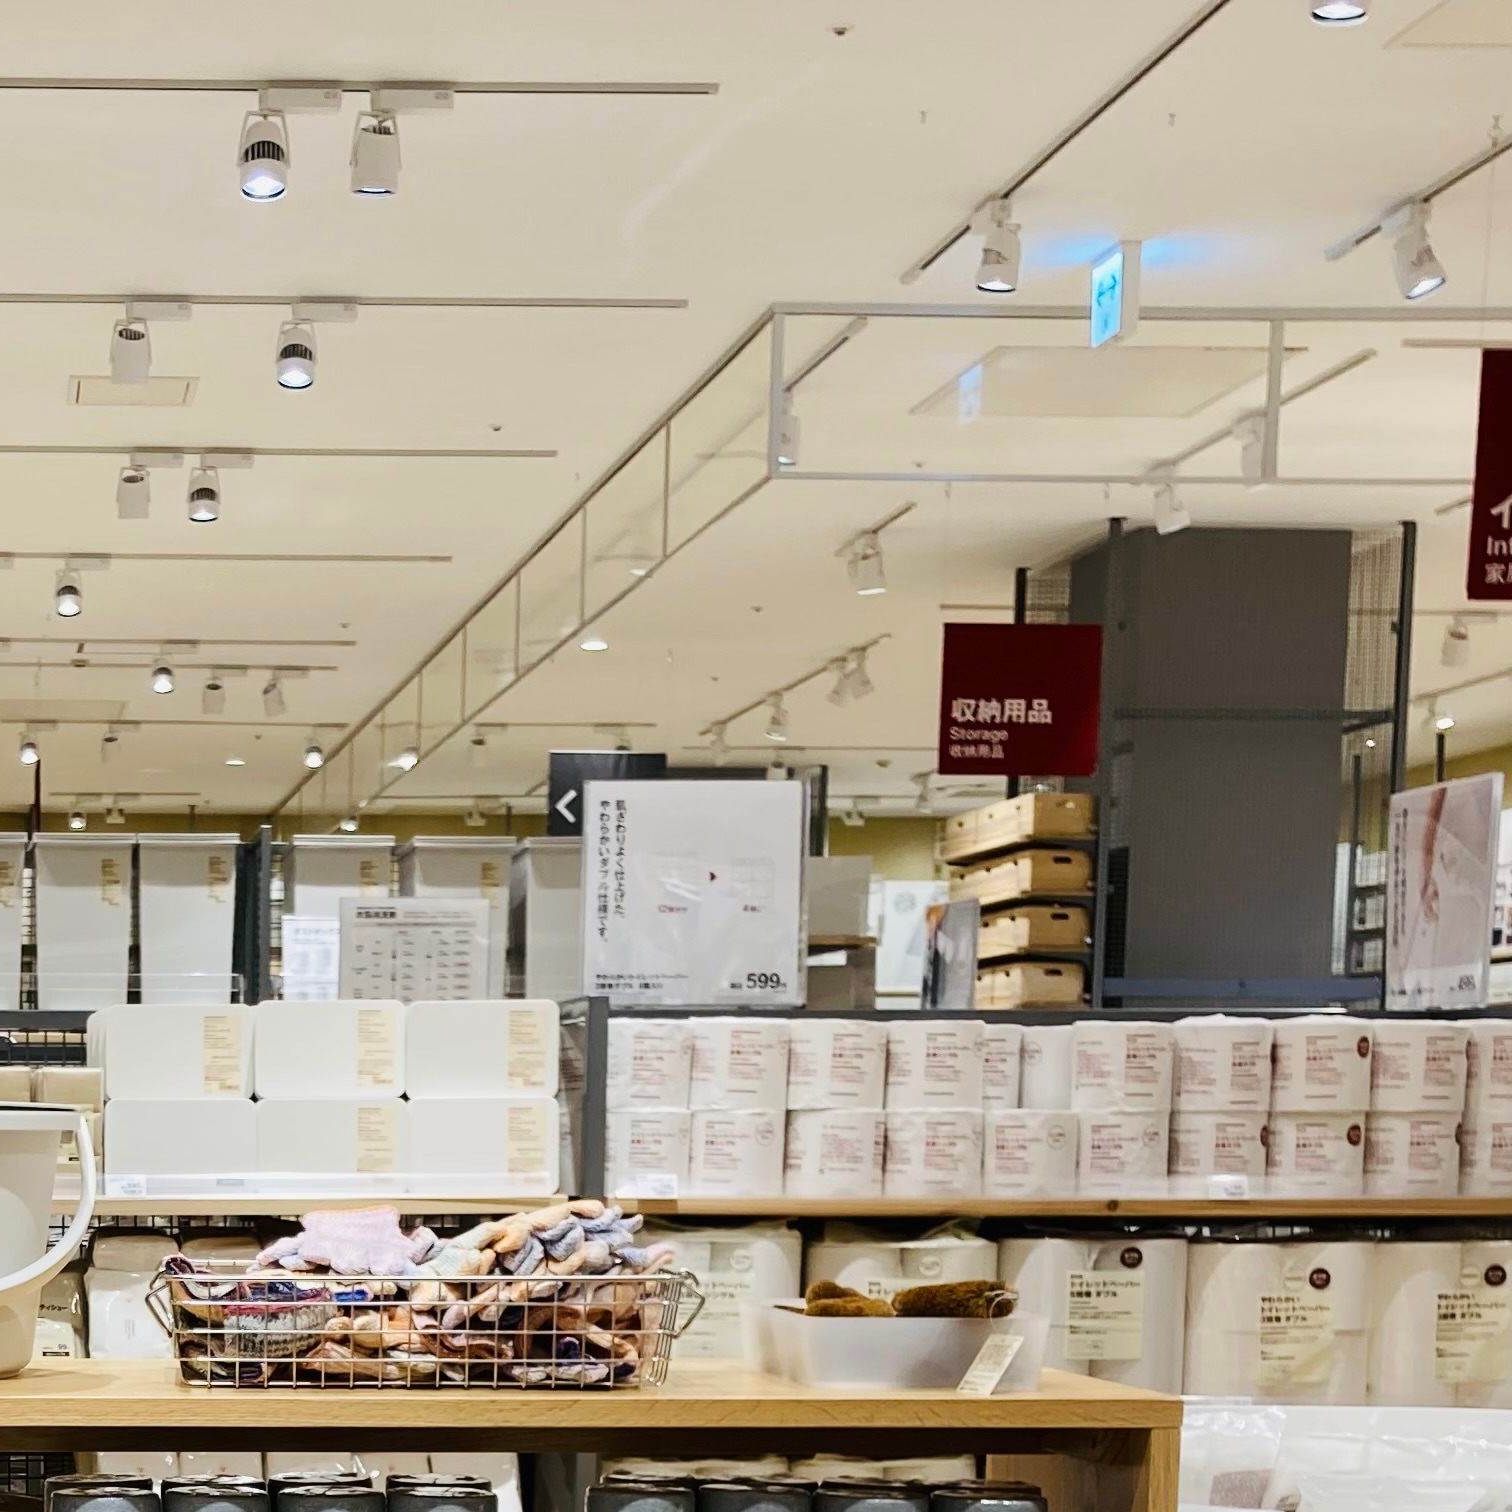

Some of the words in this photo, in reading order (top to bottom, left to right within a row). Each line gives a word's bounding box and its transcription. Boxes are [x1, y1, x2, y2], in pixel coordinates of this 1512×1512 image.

[951, 698, 1053, 724] 収納用品
[950, 726, 1008, 742] Storage
